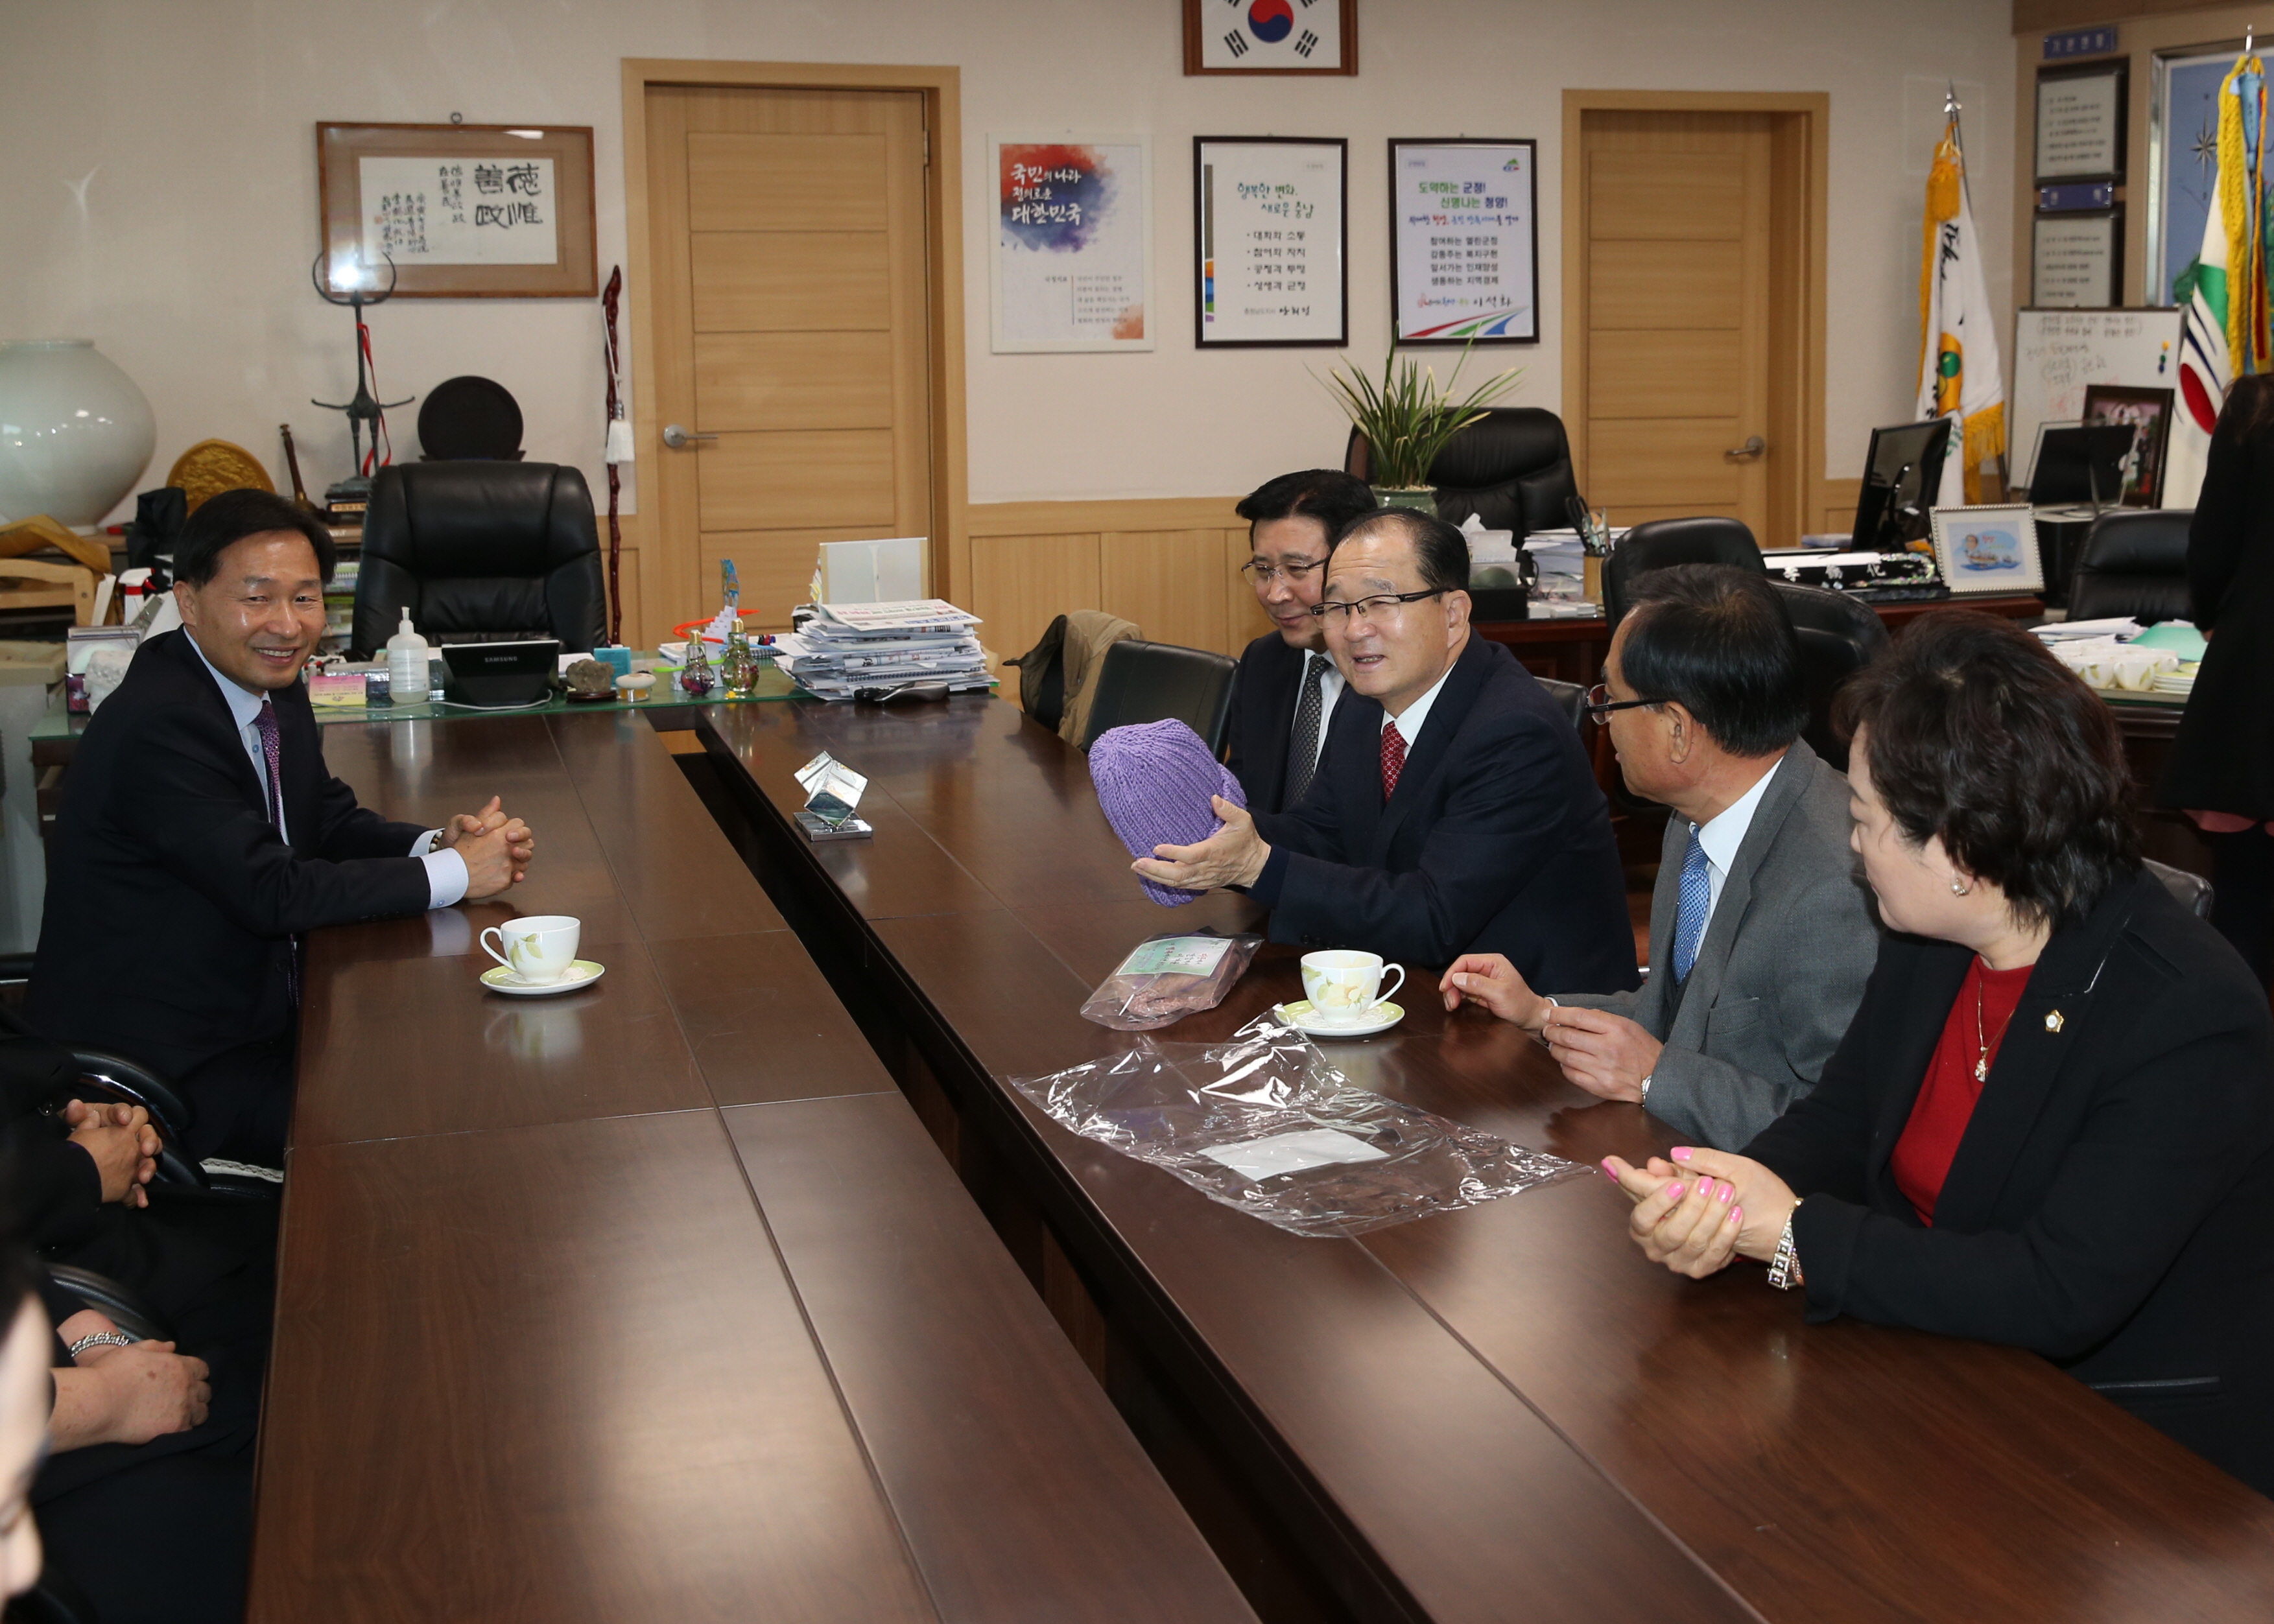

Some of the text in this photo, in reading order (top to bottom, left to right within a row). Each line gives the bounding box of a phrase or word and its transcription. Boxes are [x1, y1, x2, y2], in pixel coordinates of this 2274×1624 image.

[1010, 163, 1082, 185] 국민의 나라
[1237, 182, 1271, 200] 행복한
[1419, 182, 1486, 193] 도약하는 군정!
[1012, 187, 1052, 202] 정의로운
[1441, 197, 1508, 209] 신명나는 청양!
[1012, 202, 1082, 226] 대한민국
[1261, 200, 1314, 219] 새로운 충남
[1430, 236, 1498, 246] 참여하는 열린군정
[1431, 250, 1462, 259] 감동주는
[1466, 263, 1498, 272] 인재양성
[1467, 276, 1499, 286] 지역경제
